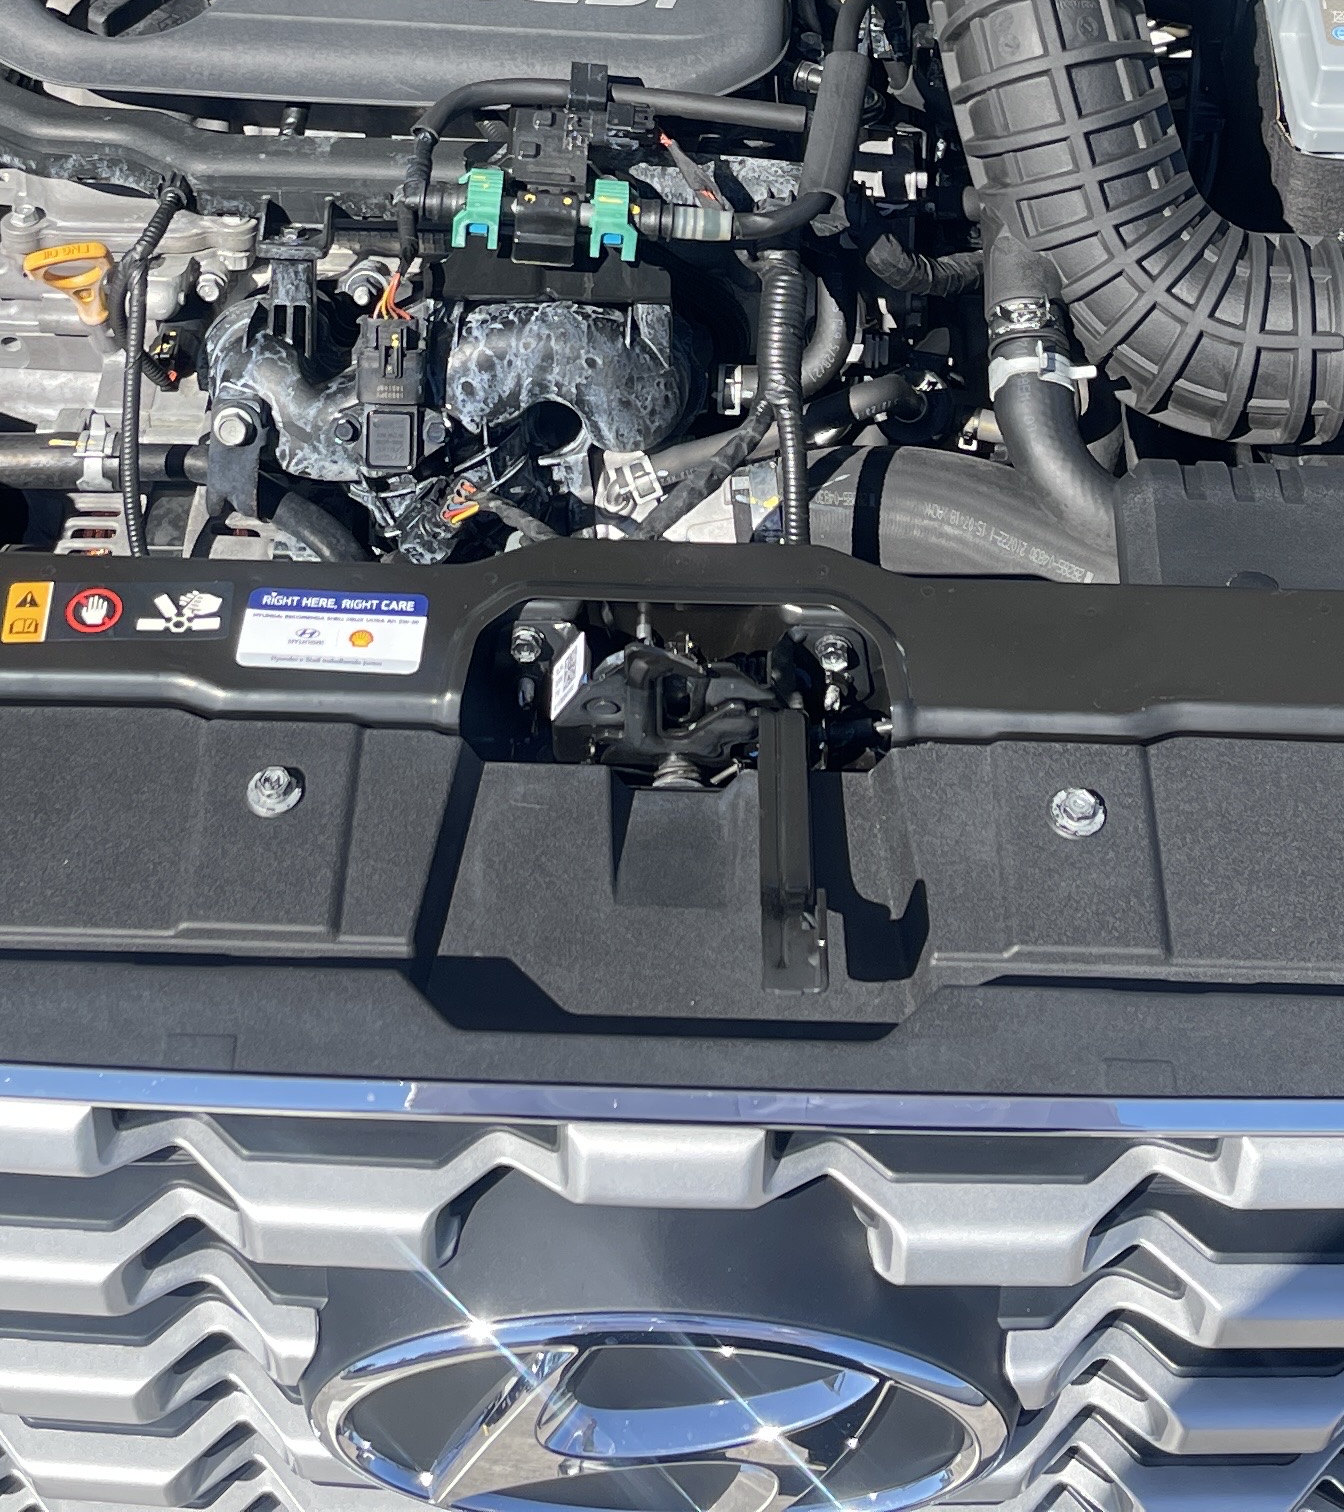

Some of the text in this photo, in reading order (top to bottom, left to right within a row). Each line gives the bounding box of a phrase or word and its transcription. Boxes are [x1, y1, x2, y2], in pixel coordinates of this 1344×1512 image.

[301, 596, 338, 609] HERE,
[341, 598, 379, 611] RIGHT
[380, 600, 415, 612] CARE
